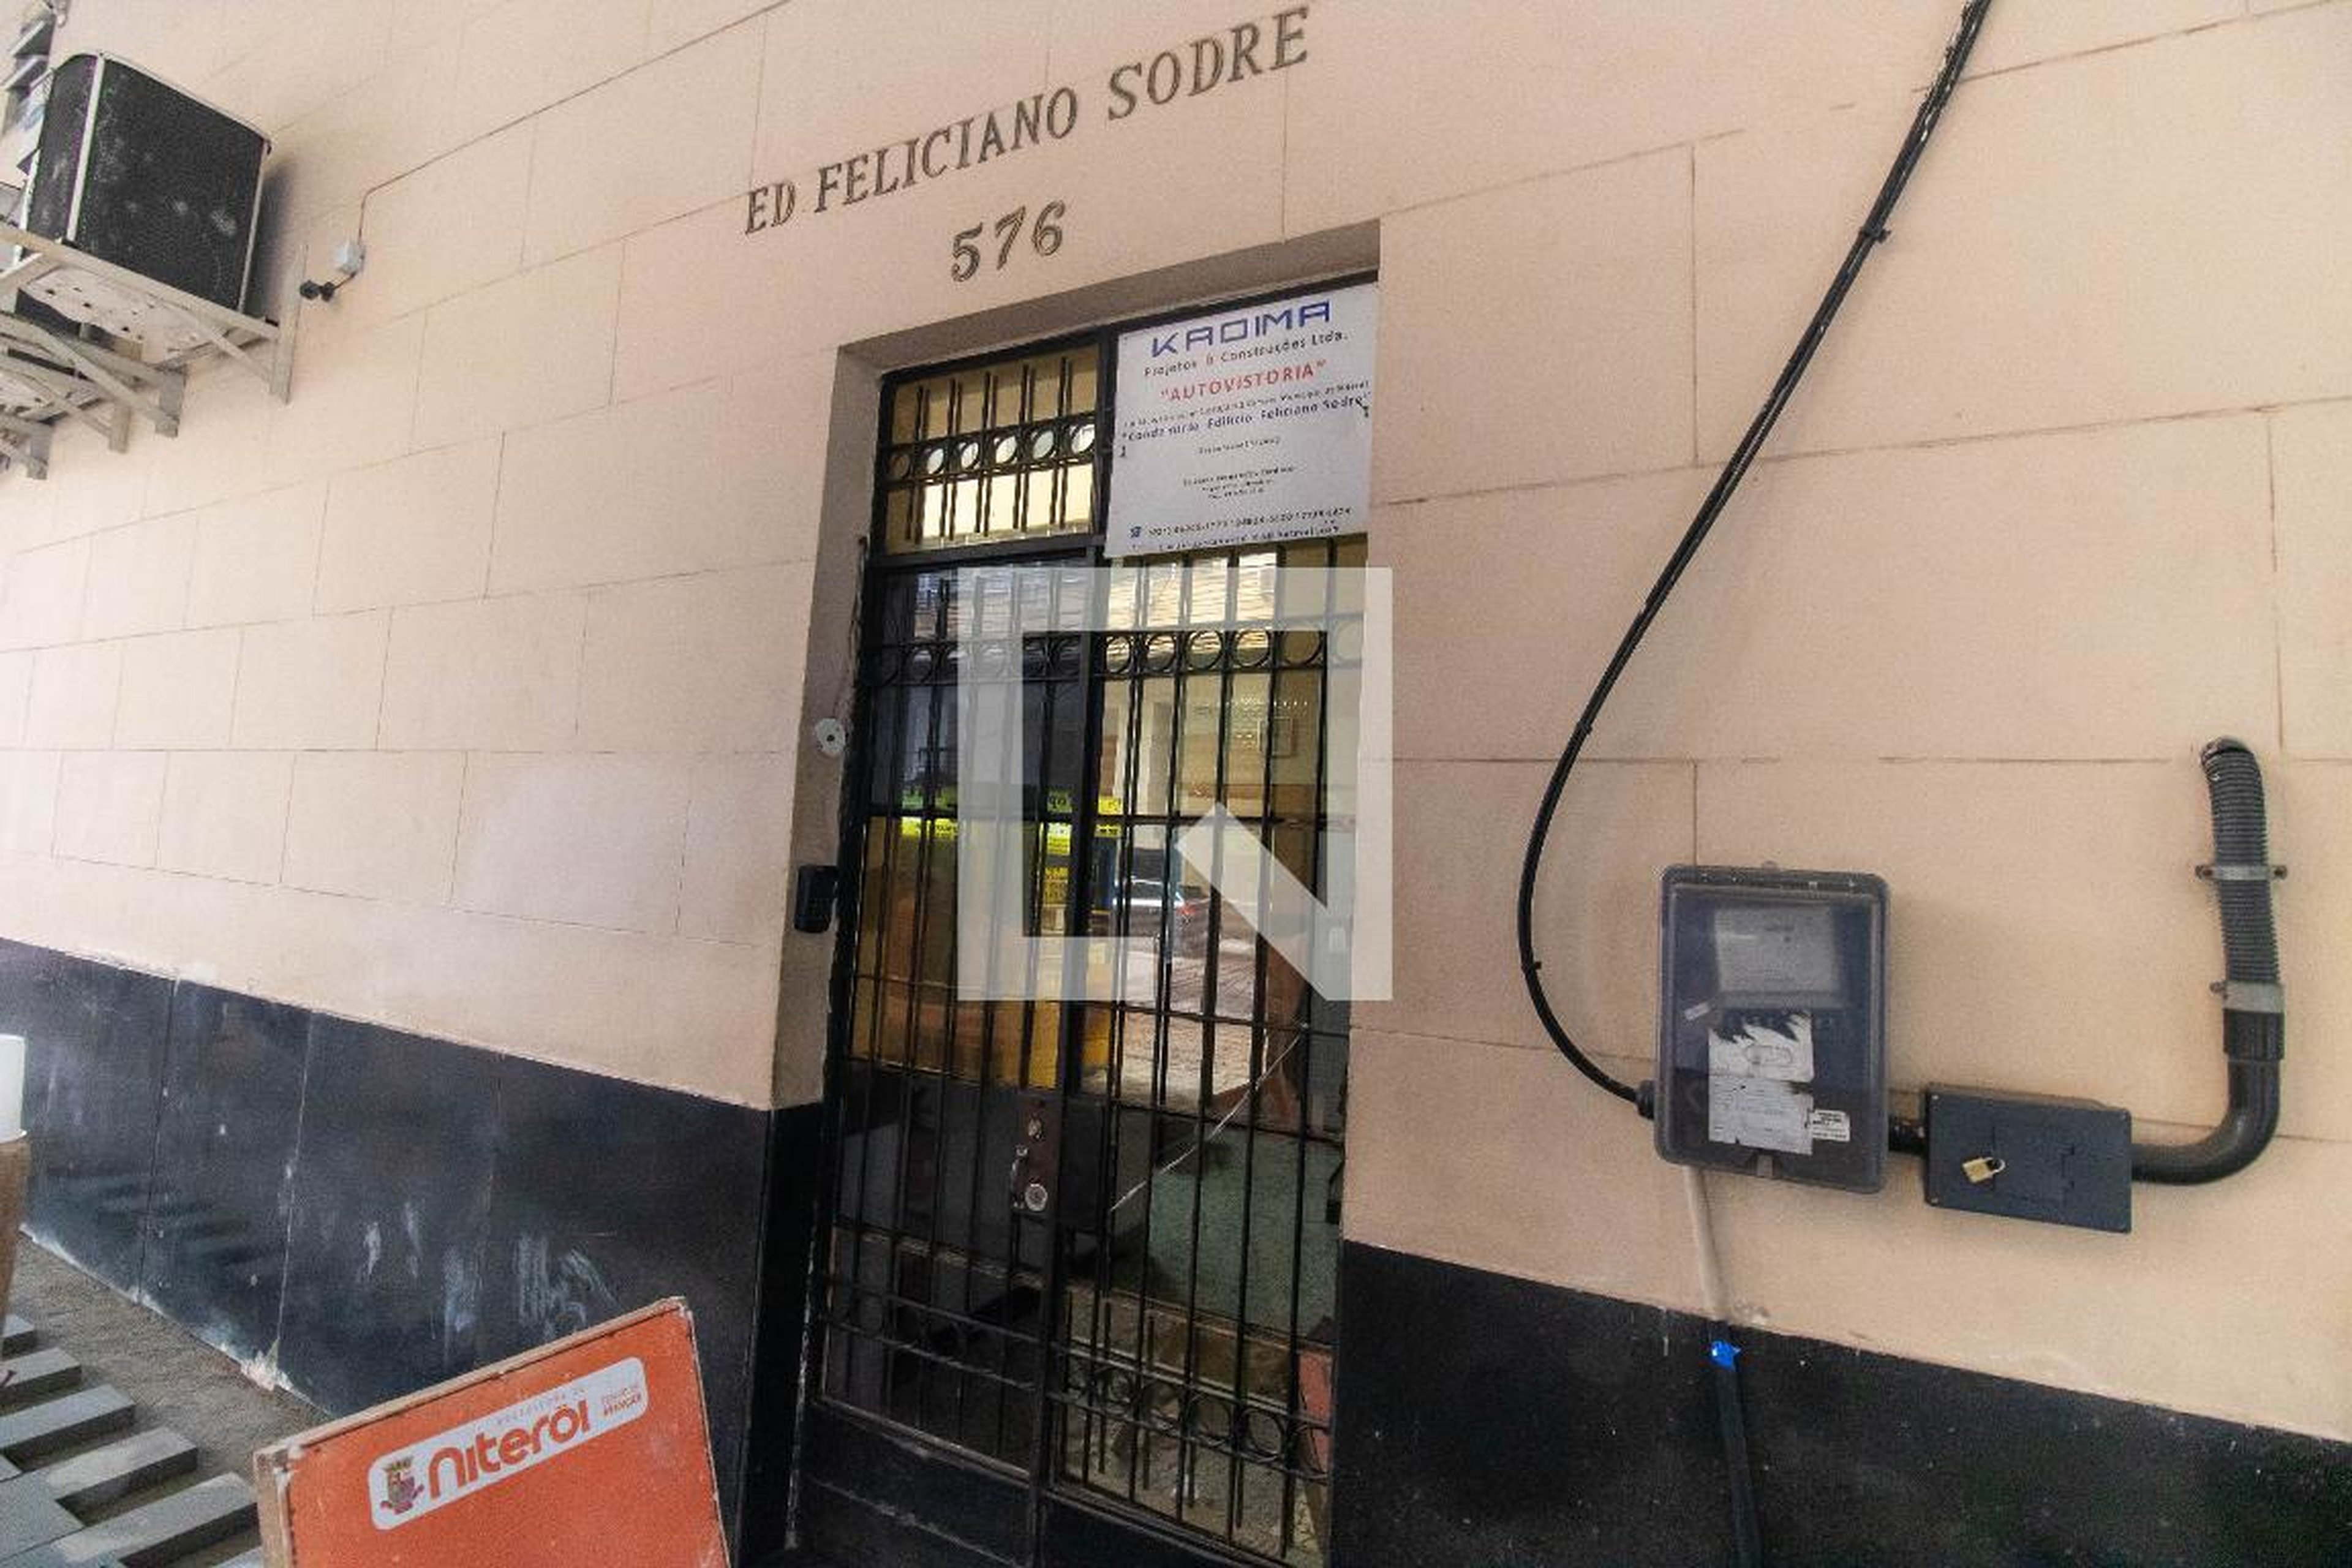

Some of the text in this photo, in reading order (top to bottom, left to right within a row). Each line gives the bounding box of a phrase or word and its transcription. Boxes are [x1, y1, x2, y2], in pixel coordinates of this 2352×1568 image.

[744, 6, 1309, 234] ED FELICIANO SODRE
[951, 200, 1066, 282] 576
[1145, 361, 1196, 376] Projetos
[1221, 338, 1305, 362] Construções
[1312, 331, 1348, 345] Ltda.
